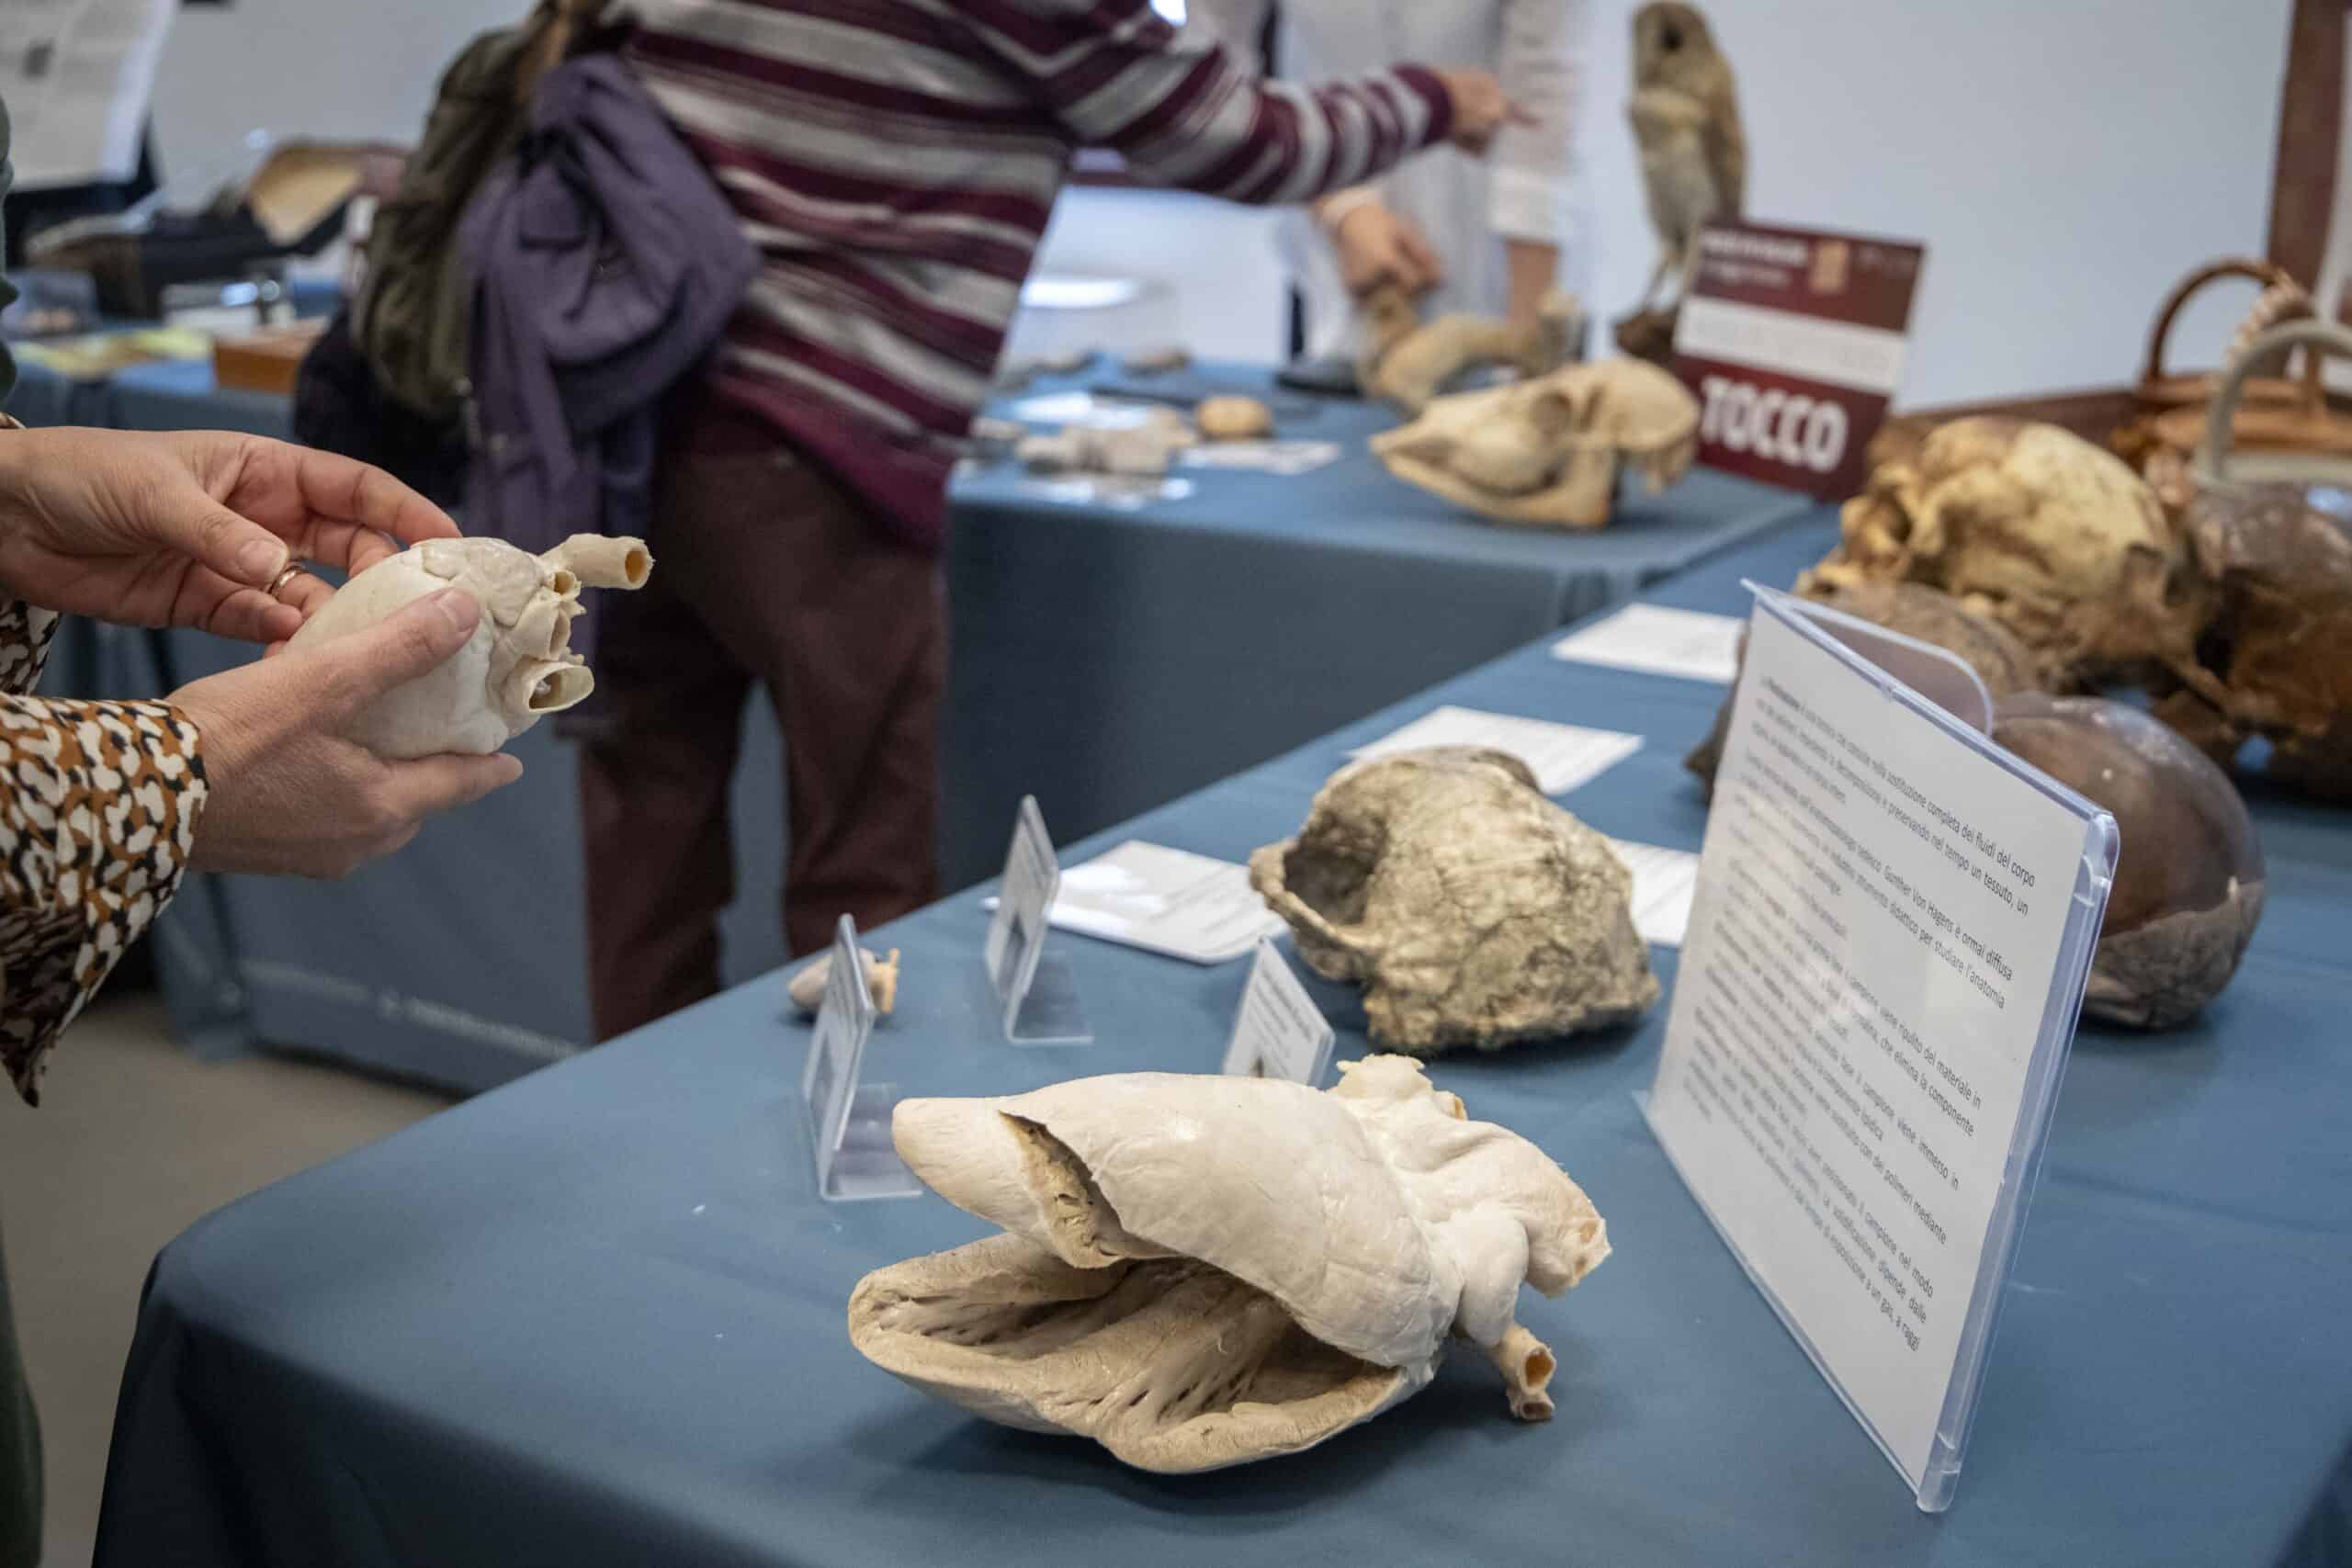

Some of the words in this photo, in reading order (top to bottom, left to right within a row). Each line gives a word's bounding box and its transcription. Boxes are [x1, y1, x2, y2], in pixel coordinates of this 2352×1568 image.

[1700, 375, 1849, 473] TOCCO
[1886, 772, 1927, 808] sostituzione
[1928, 801, 1960, 834] completa
[1962, 824, 1974, 843] dei
[1976, 831, 1996, 858] fluidi
[1996, 850, 2010, 869] del
[2011, 863, 2035, 886] corpo
[1931, 835, 1945, 852] nel
[1945, 843, 1969, 871] tempo
[1984, 872, 2013, 908] tessuto,
[1889, 902, 1918, 933] didattico
[1918, 930, 1933, 948] per
[1935, 941, 1963, 974] studiare
[1966, 964, 2005, 1009] l'anatomia
[1913, 889, 1926, 910] Von
[1928, 901, 1954, 933] Hagens
[1962, 933, 1984, 958] ormai
[1986, 950, 2012, 980] diffusa
[1894, 1051, 1918, 1082] elimina
[1928, 1086, 1973, 1139] componente
[1899, 1021, 1922, 1054] ripulito
[1924, 1048, 1936, 1066] del
[1937, 1061, 1972, 1100] materiale
[1918, 1138, 1948, 1179] immerso
[1883, 1169, 1913, 1206] polimeri
[1914, 1201, 1946, 1245] mediante
[1865, 1213, 1896, 1255] campione
[1899, 1252, 1911, 1269] nel
[1912, 1268, 1933, 1301] modo
[1879, 1260, 1906, 1301] dipende
[1909, 1297, 1926, 1323] dalle
